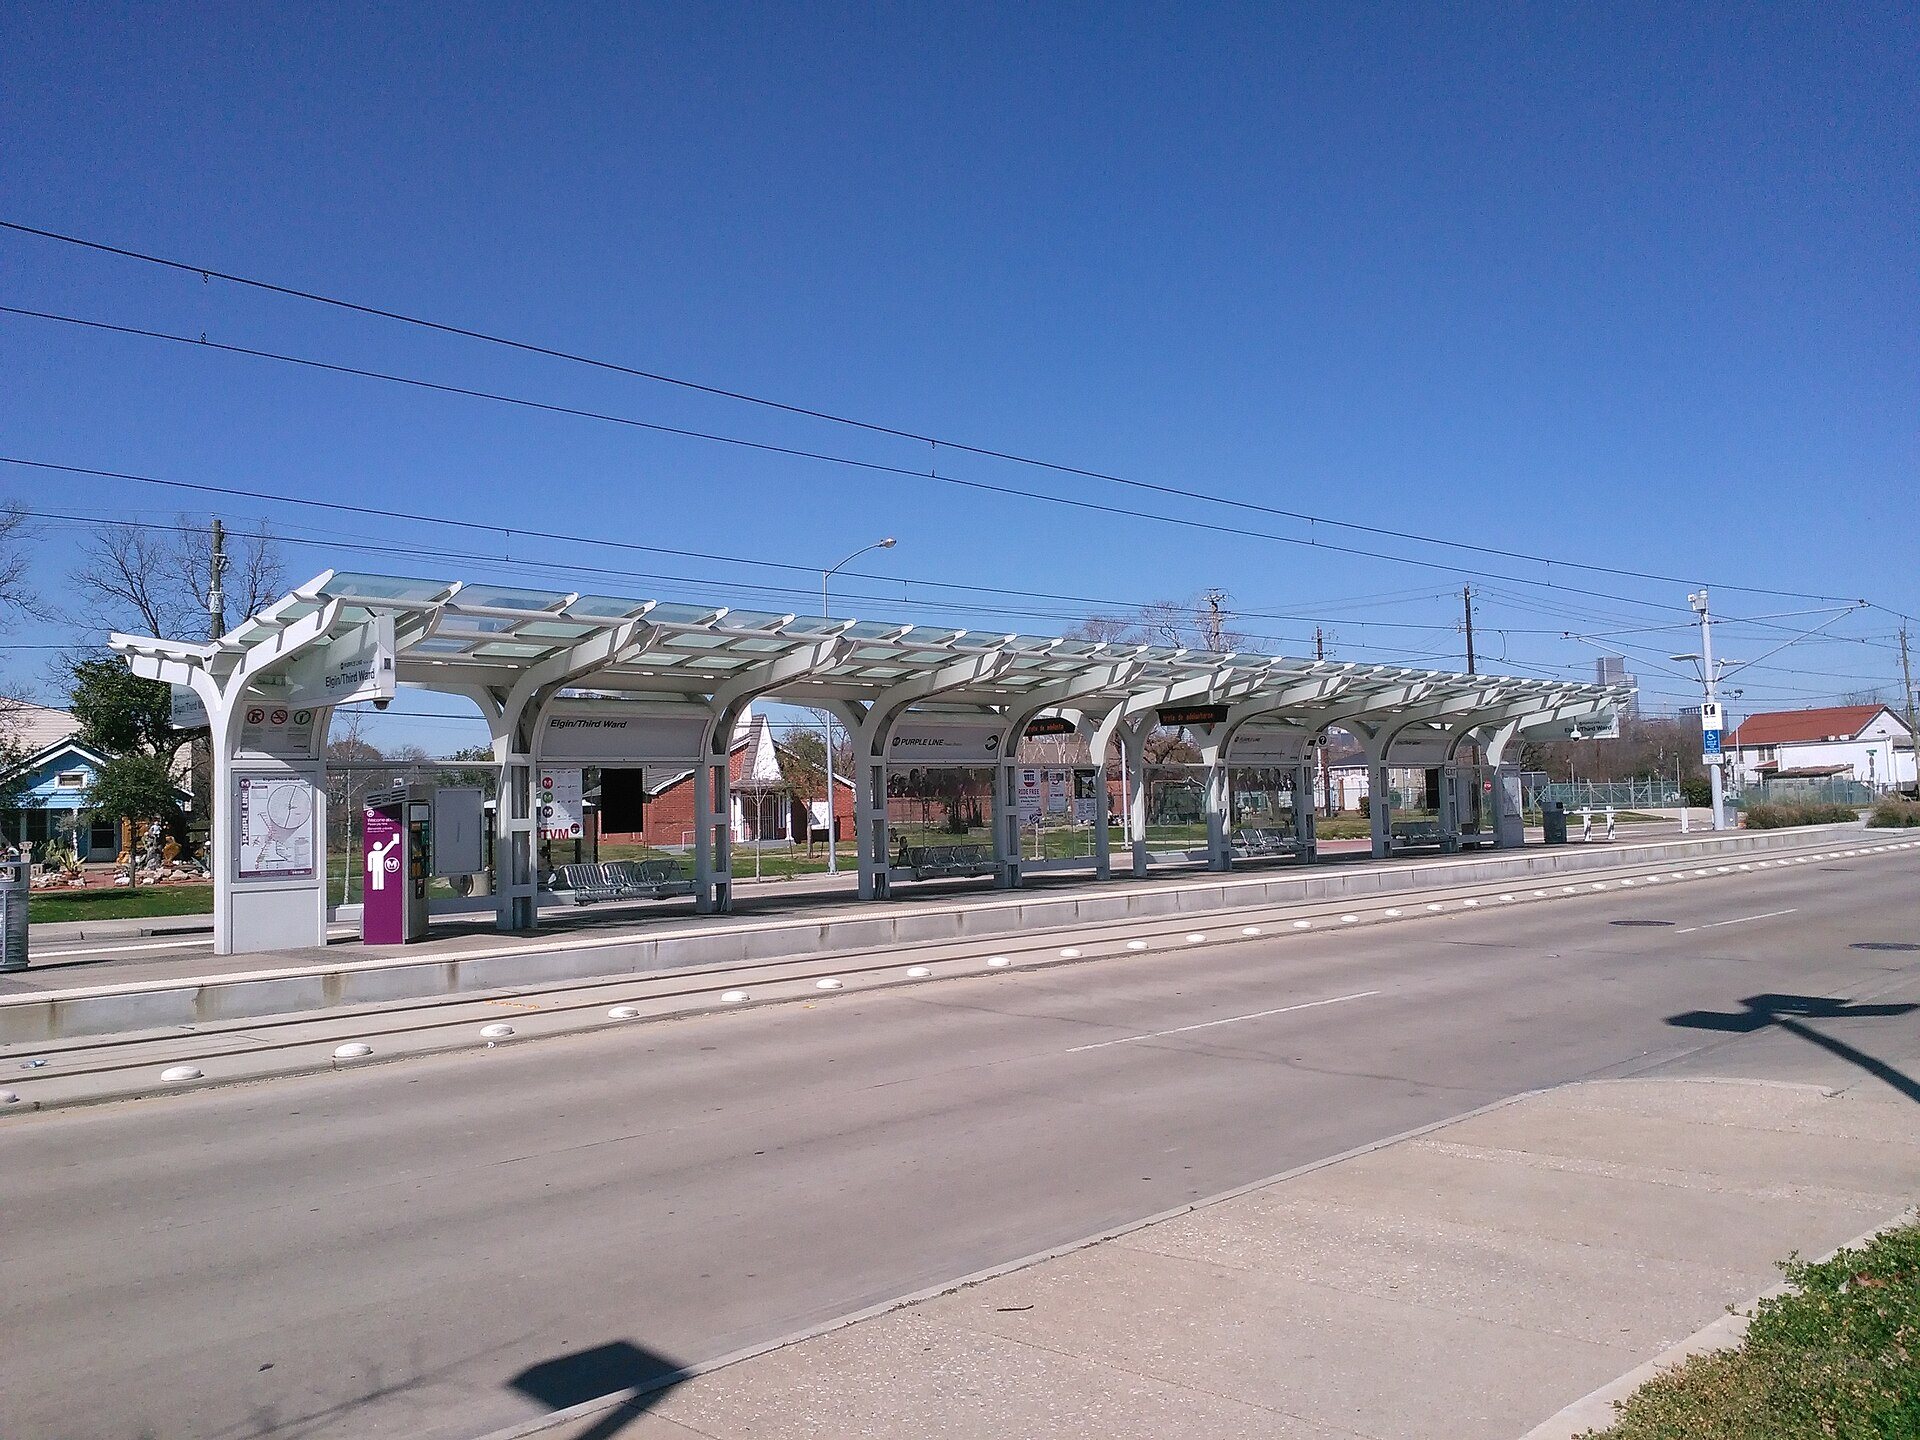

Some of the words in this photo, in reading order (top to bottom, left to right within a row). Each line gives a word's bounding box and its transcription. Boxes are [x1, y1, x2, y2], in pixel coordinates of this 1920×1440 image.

[325, 671, 357, 688] Elgin/Third
[358, 668, 375, 681] Ward
[550, 719, 601, 729] Elgin/Third
[603, 720, 627, 729] Ward
[900, 738, 927, 746] PURPLE
[928, 738, 944, 746] LINE
[541, 829, 569, 840] TVM
